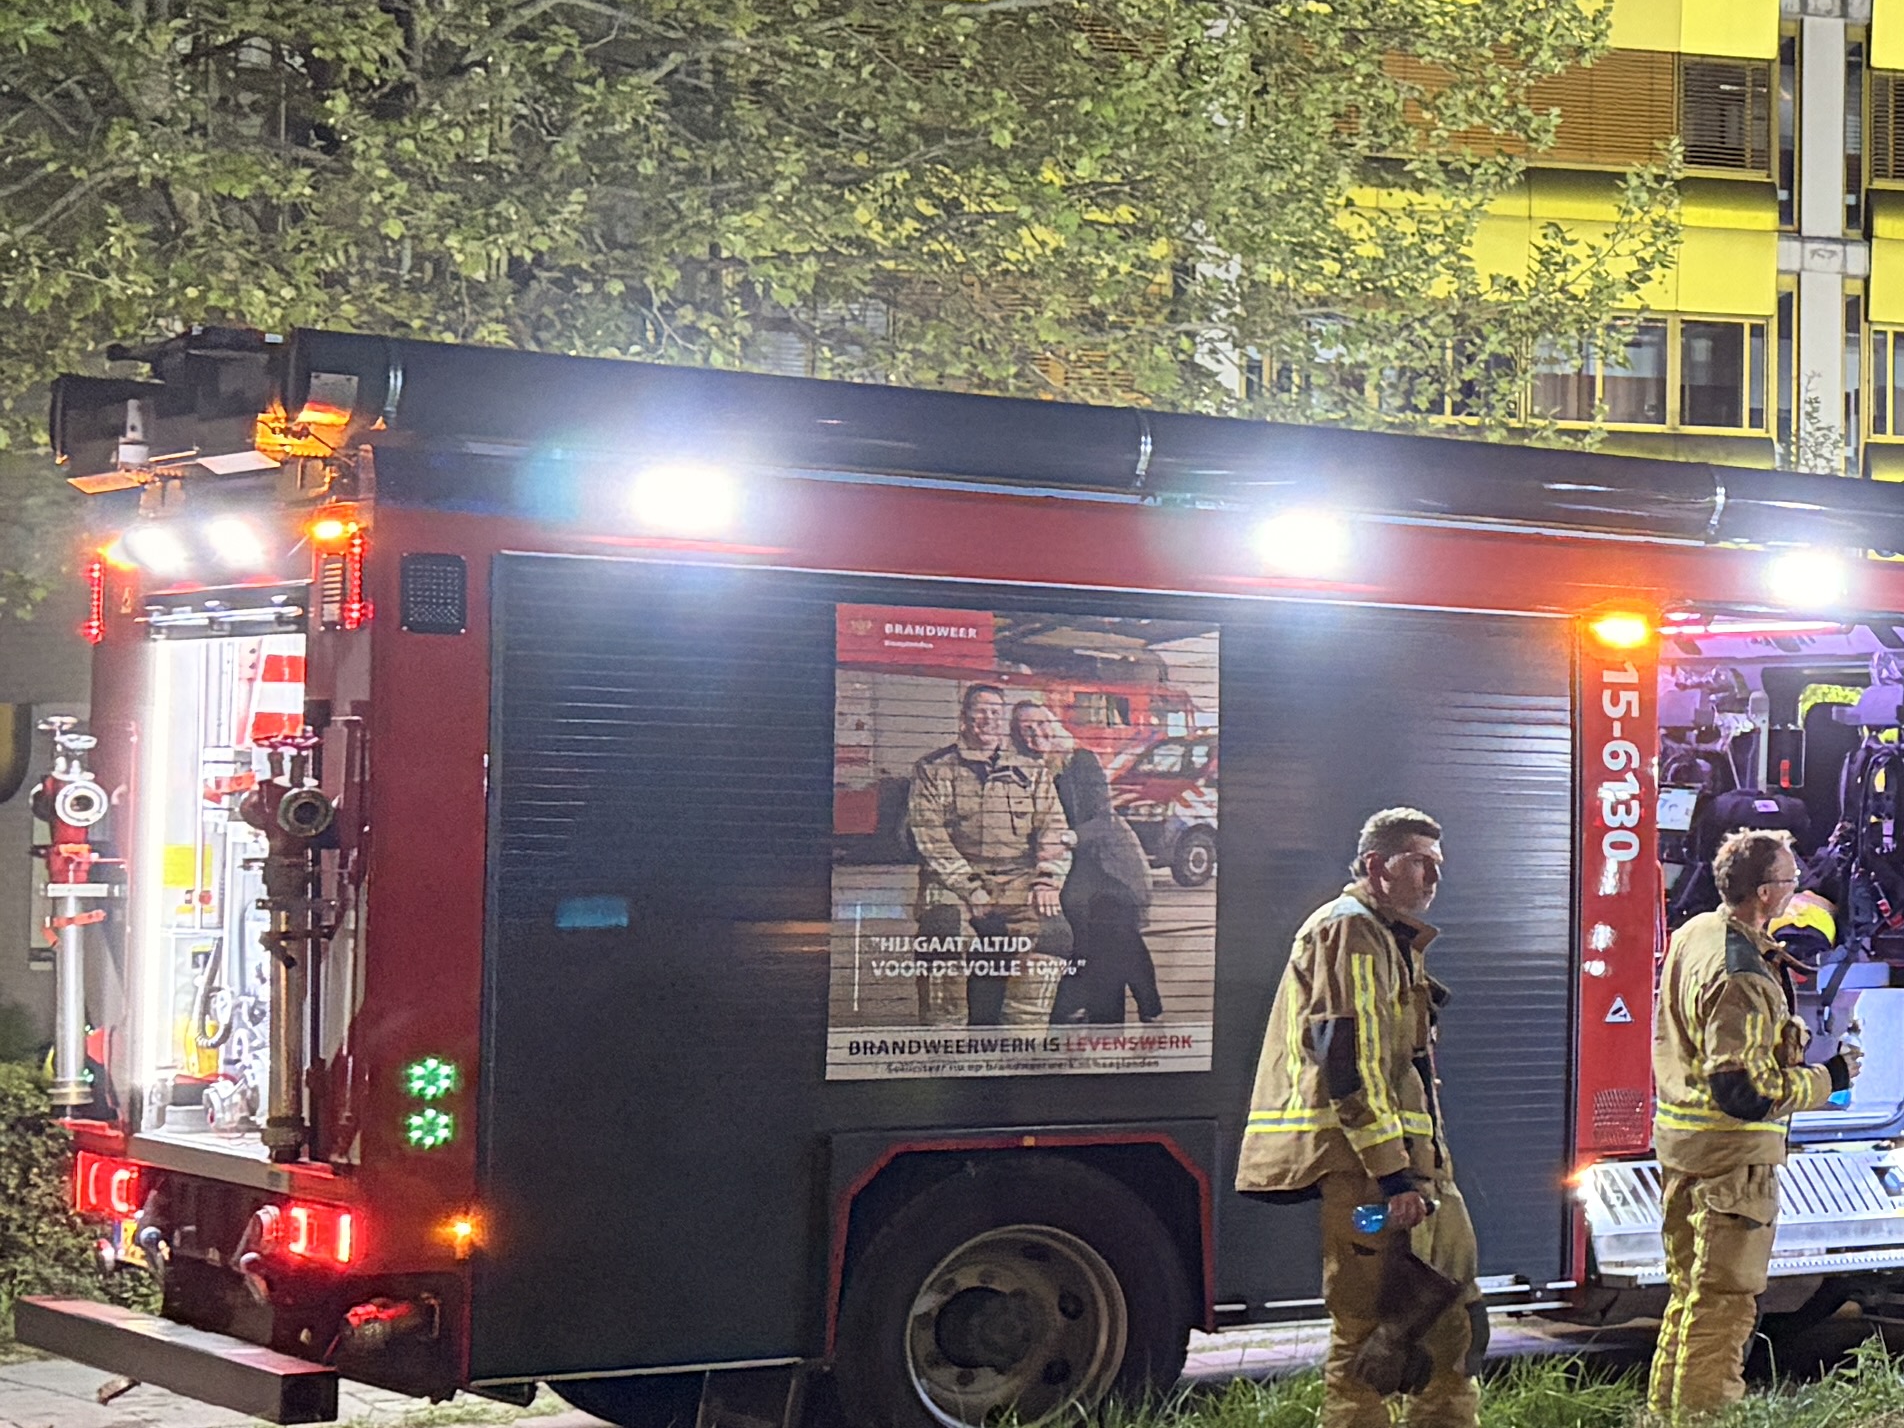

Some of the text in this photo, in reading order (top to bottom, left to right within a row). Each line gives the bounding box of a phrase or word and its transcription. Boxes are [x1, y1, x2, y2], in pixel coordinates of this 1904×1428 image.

[884, 623, 977, 639] BRANDWEER
[1602, 661, 1640, 861] 15-6130
[913, 936, 967, 953] GAAT
[969, 936, 1032, 953] ALTIJD
[871, 960, 928, 977] VOOR
[932, 960, 962, 977] DE
[963, 959, 1021, 976] VOLLE
[849, 1035, 1193, 1056] BRANDWEERWERK IS LEVENSWERK
